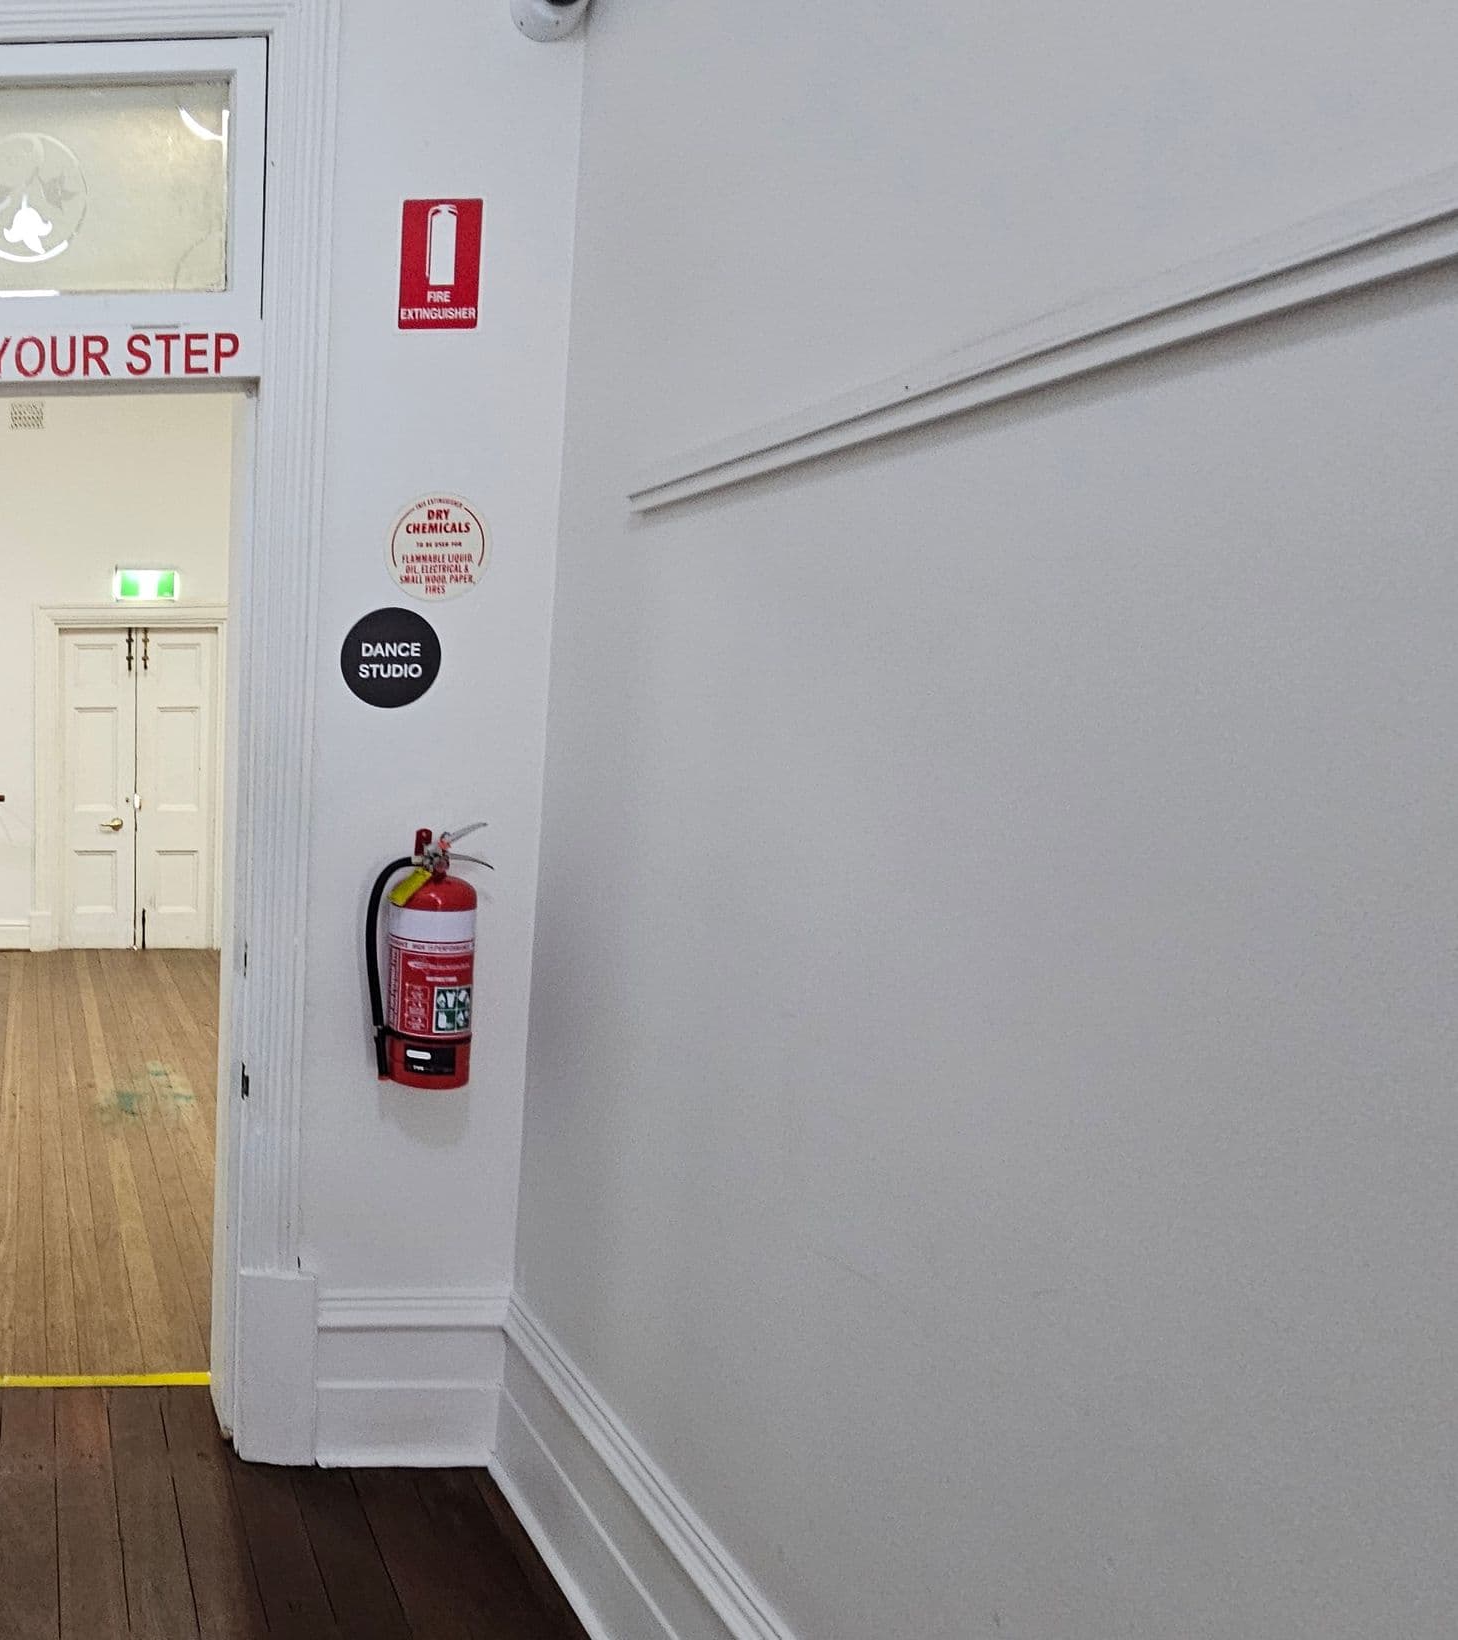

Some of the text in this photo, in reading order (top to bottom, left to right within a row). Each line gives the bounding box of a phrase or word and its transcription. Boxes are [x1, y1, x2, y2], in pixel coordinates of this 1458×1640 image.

[427, 290, 451, 303] FIRE
[400, 308, 476, 320] EXTINGUISHER
[125, 332, 240, 376] STEP
[427, 509, 450, 520] DRY
[405, 522, 471, 534] CHEMICALS
[402, 553, 445, 563] FLAMMABLE
[421, 564, 462, 574] ELECTRICAL
[400, 575, 422, 585] SMALL
[425, 585, 446, 595] FIRES
[361, 642, 421, 657] DANCE
[358, 663, 422, 678] STUDIO
